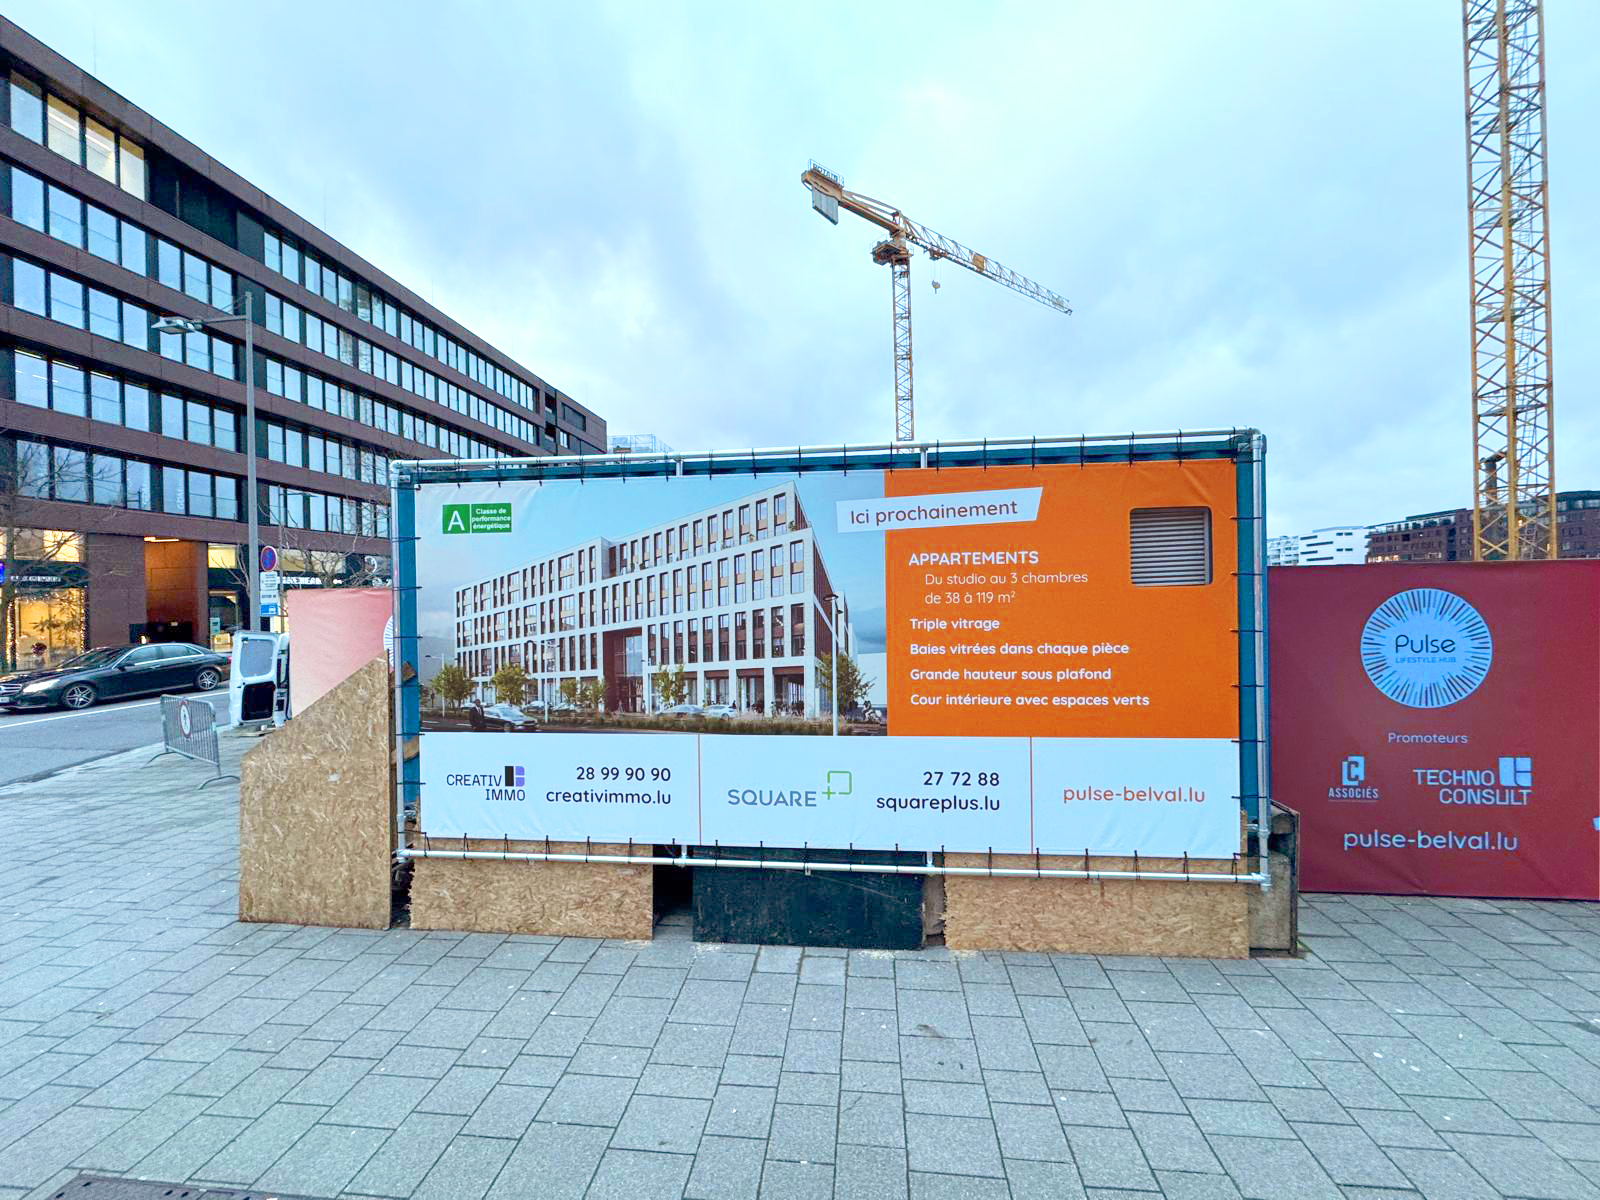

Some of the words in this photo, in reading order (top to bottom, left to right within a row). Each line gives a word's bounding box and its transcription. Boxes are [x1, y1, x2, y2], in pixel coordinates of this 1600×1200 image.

[447, 510, 465, 531] A
[850, 508, 869, 524] Ici
[876, 501, 1018, 526] prochainement
[472, 522, 510, 530] énergétique
[908, 551, 1039, 566] APPARTEMENTS
[925, 574, 943, 585] Du
[947, 573, 986, 585] studio
[990, 575, 1006, 584] au
[1010, 572, 1018, 584] 3
[1021, 572, 1088, 584] chambres
[925, 592, 941, 604] de
[945, 592, 960, 604] 38
[964, 591, 973, 604] à
[976, 591, 994, 604] 119
[997, 591, 1016, 604] m²
[910, 618, 947, 632] Triple
[951, 617, 1000, 631] vitrage
[910, 644, 946, 655] Baies
[950, 643, 996, 655] vitrées
[999, 643, 1033, 655] dans
[1037, 643, 1088, 656] chaque
[1092, 642, 1130, 656] pièce
[1395, 634, 1456, 654] Pulse
[1395, 656, 1436, 664] LIFESTYLE
[910, 668, 960, 680] Grande
[963, 668, 1017, 680] hauteur
[1021, 670, 1053, 680] sous
[1056, 667, 1112, 682] plafond
[910, 694, 942, 705] Cour
[946, 693, 1012, 705] intérieure
[1015, 696, 1048, 705] avec
[1052, 696, 1109, 708] espaces
[1113, 694, 1150, 706] verts
[1388, 732, 1469, 744] Promoteurs
[446, 774, 502, 787] CREATIV
[576, 766, 595, 780] 28
[600, 767, 620, 780] 99
[625, 767, 645, 781] 90
[650, 767, 671, 782] 90
[923, 771, 944, 786] 27
[951, 771, 971, 786] 72
[978, 772, 1000, 786] 88
[1413, 770, 1495, 786] TECHNO
[485, 789, 526, 801] IMMO
[546, 789, 671, 804] creativimmo.lu
[728, 789, 817, 807] SQUARE
[1063, 785, 1205, 804] pulse-belval.lu
[1328, 786, 1379, 799] ASSOCIÉS
[1439, 789, 1532, 805] CONSULT
[876, 795, 1000, 813] squareplus.lu
[1344, 829, 1518, 851] pulse-belval.lu
